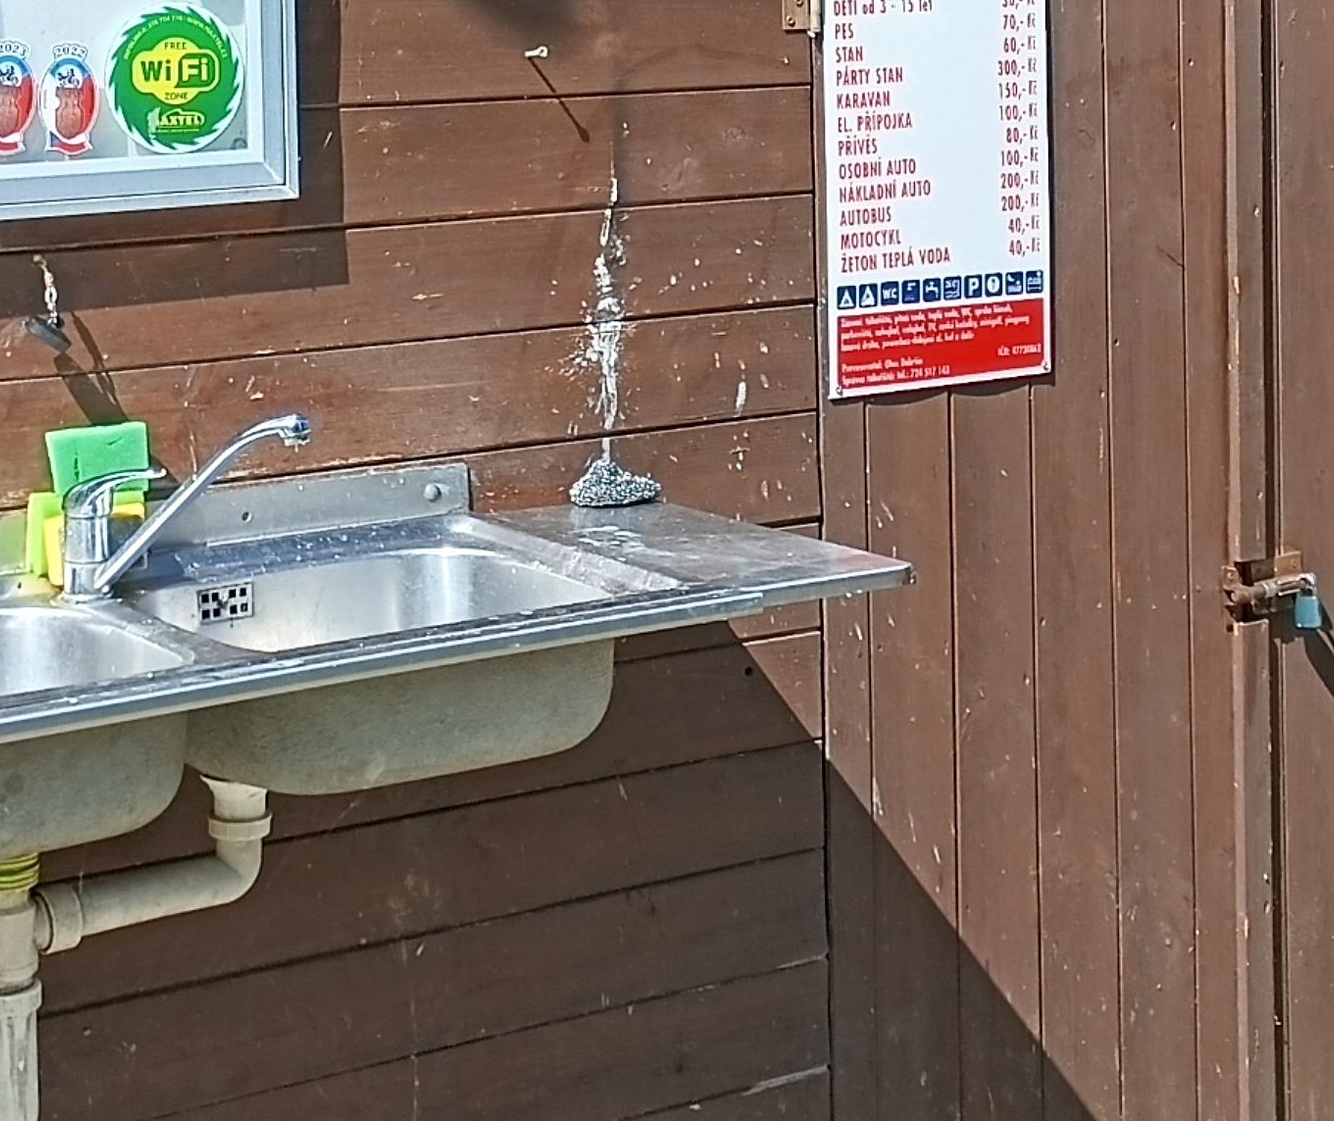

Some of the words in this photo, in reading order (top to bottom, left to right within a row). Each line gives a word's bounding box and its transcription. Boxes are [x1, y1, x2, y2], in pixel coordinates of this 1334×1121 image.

[835, 22, 854, 40] PES
[1003, 14, 1024, 32] 70,-
[54, 46, 86, 58] 2022
[164, 42, 187, 50] FREE
[835, 46, 863, 63] STAN
[1003, 37, 1024, 55] 60,-
[836, 65, 870, 86] PÁRTY
[876, 67, 903, 84] STAN
[997, 60, 1025, 77] 300,-
[164, 92, 189, 100] ZONE
[836, 91, 890, 109] KARAVAN
[838, 117, 852, 133] EL.
[857, 111, 912, 132] PŘÍPOJKA
[999, 105, 1027, 122] 100,-
[838, 135, 878, 157] PŘÍVĚS
[839, 156, 882, 179] OSOBNÍ
[887, 158, 916, 175] AUTO
[1001, 150, 1028, 167] 100,-
[839, 179, 897, 203] NÁKLADNÍ
[902, 180, 931, 198] AUTO
[1001, 173, 1029, 190] 200,-
[840, 206, 892, 226] AUTOBUS
[1001, 196, 1029, 212] 200,-
[841, 229, 901, 250] MOTOCYKL
[1008, 218, 1030, 234] 40,-
[841, 252, 877, 273] ŽETON
[882, 247, 914, 269] TEPLÁ
[919, 247, 950, 265] VODA
[1009, 240, 1030, 257] 40,-
